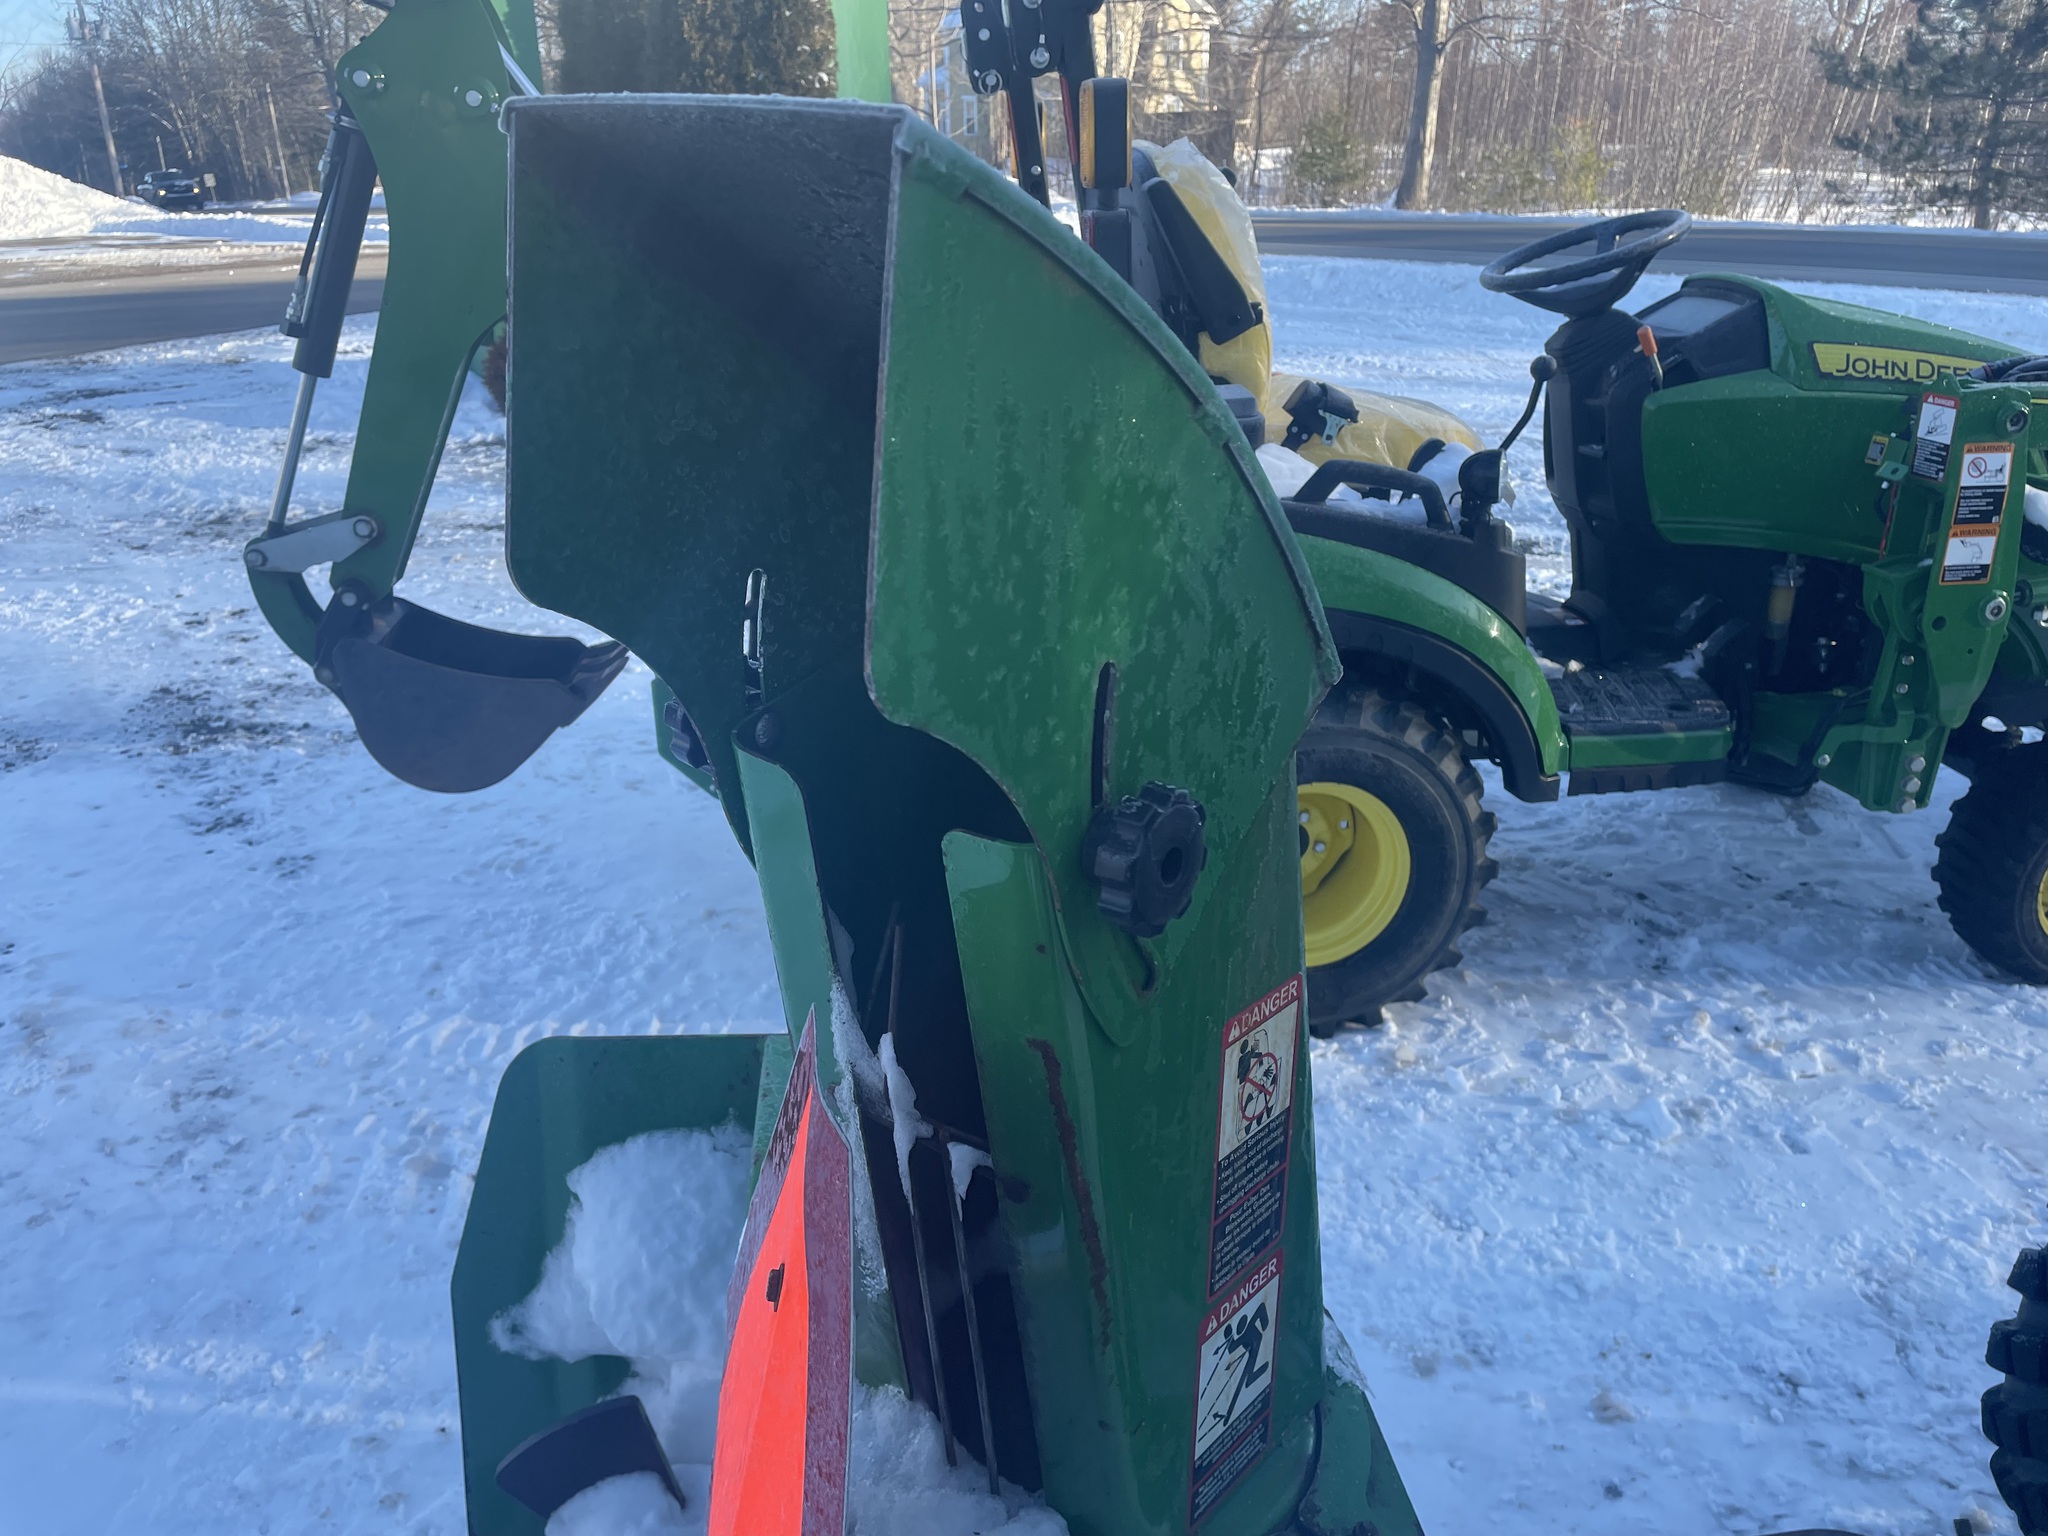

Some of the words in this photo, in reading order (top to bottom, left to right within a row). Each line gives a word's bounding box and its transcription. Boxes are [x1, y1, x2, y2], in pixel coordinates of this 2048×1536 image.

[1836, 353, 1908, 378] JOHN
[1974, 444, 2011, 453] WARNING
[1960, 528, 1997, 537] WARNING
[1241, 980, 1298, 1033] DANGER
[1221, 1160, 1228, 1168] To
[1248, 1128, 1268, 1148] Serious
[1220, 1258, 1278, 1322] DANGER
